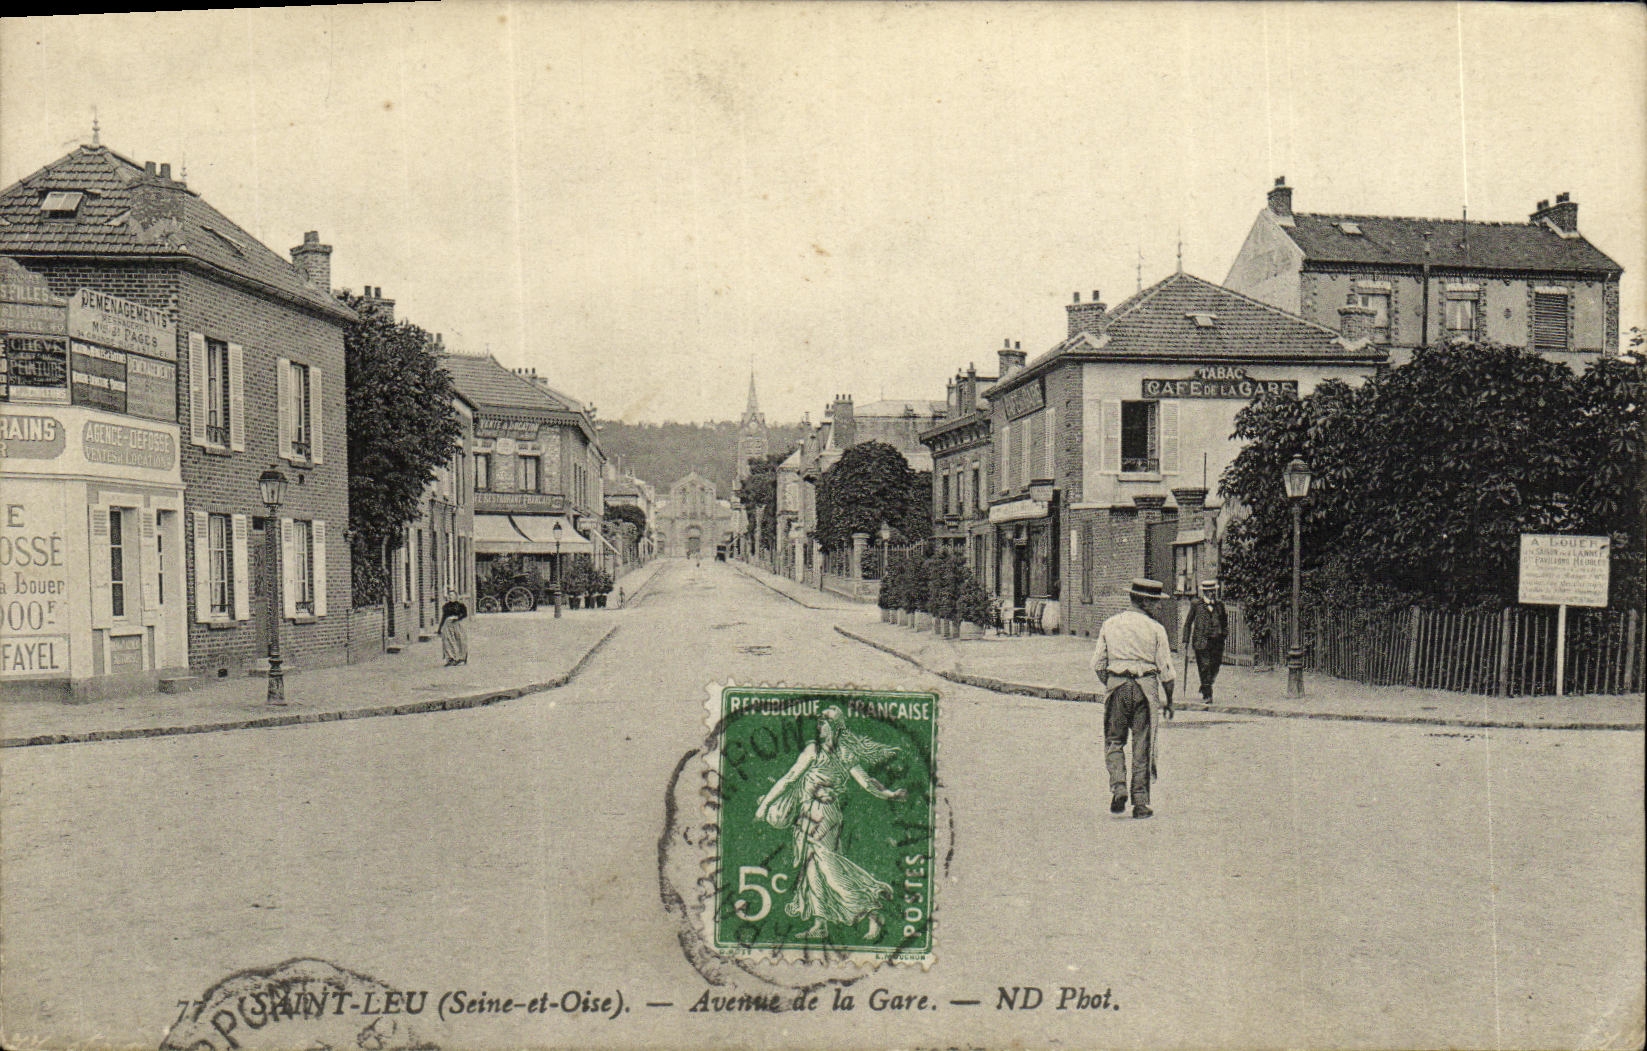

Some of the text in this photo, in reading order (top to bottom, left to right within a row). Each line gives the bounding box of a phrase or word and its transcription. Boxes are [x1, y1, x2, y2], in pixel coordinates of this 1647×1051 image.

[1200, 367, 1243, 380] TABAC
[1221, 385, 1236, 396] LA
[7, 504, 24, 527] E
[903, 854, 925, 938] POSTES
